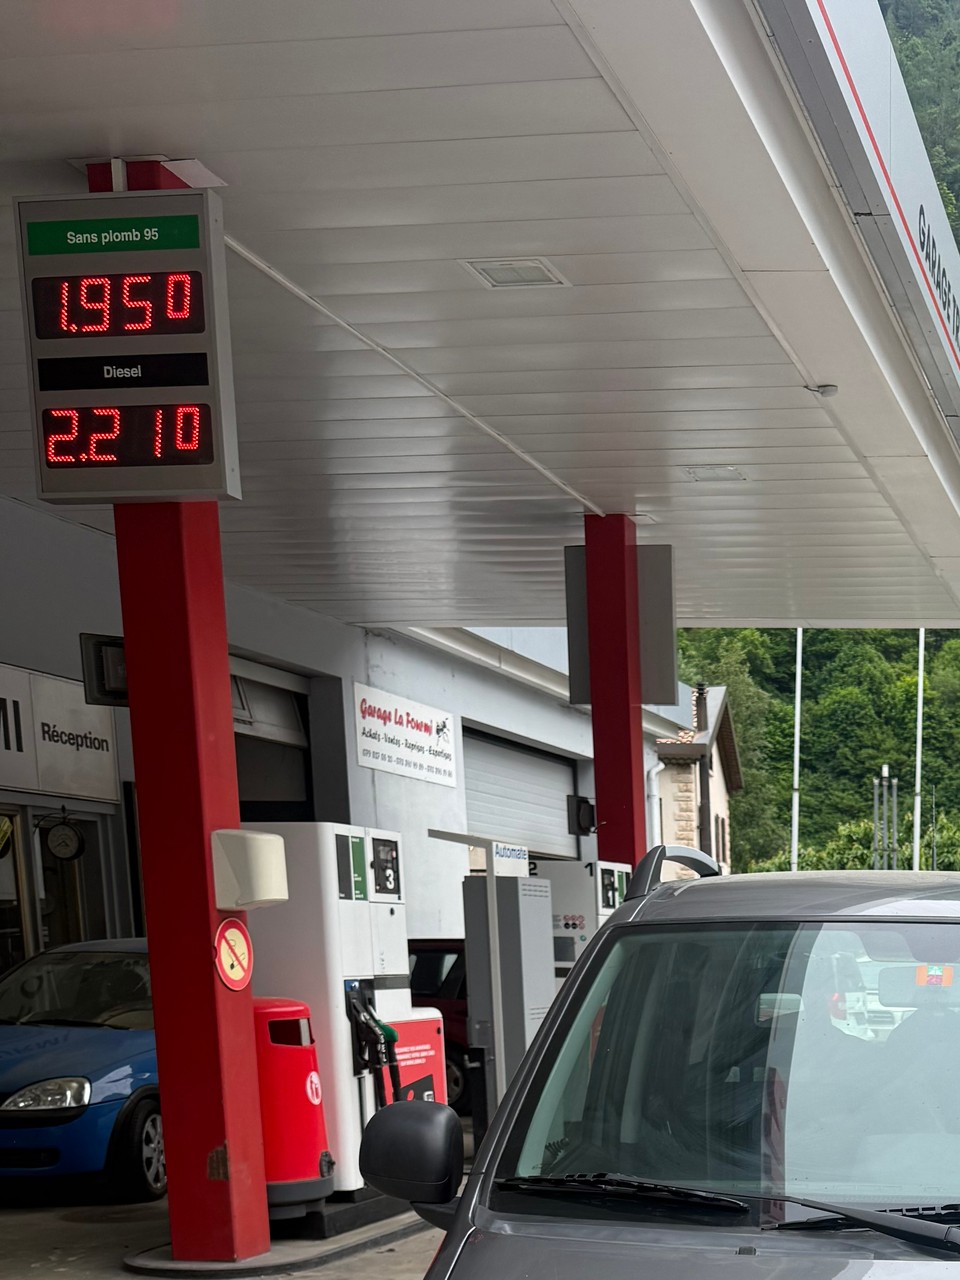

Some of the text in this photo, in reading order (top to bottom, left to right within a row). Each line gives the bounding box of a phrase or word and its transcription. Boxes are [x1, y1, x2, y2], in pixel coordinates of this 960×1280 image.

[67, 228, 159, 245] Sans plomb 95
[918, 204, 951, 325] GARAGE
[103, 364, 142, 379] Diesel
[360, 697, 392, 727] Garage
[394, 708, 404, 728] La
[41, 721, 110, 752] Réception
[495, 843, 528, 860] Automate
[528, 861, 538, 876] 2
[584, 862, 594, 877] 1
[385, 868, 395, 890] 3
